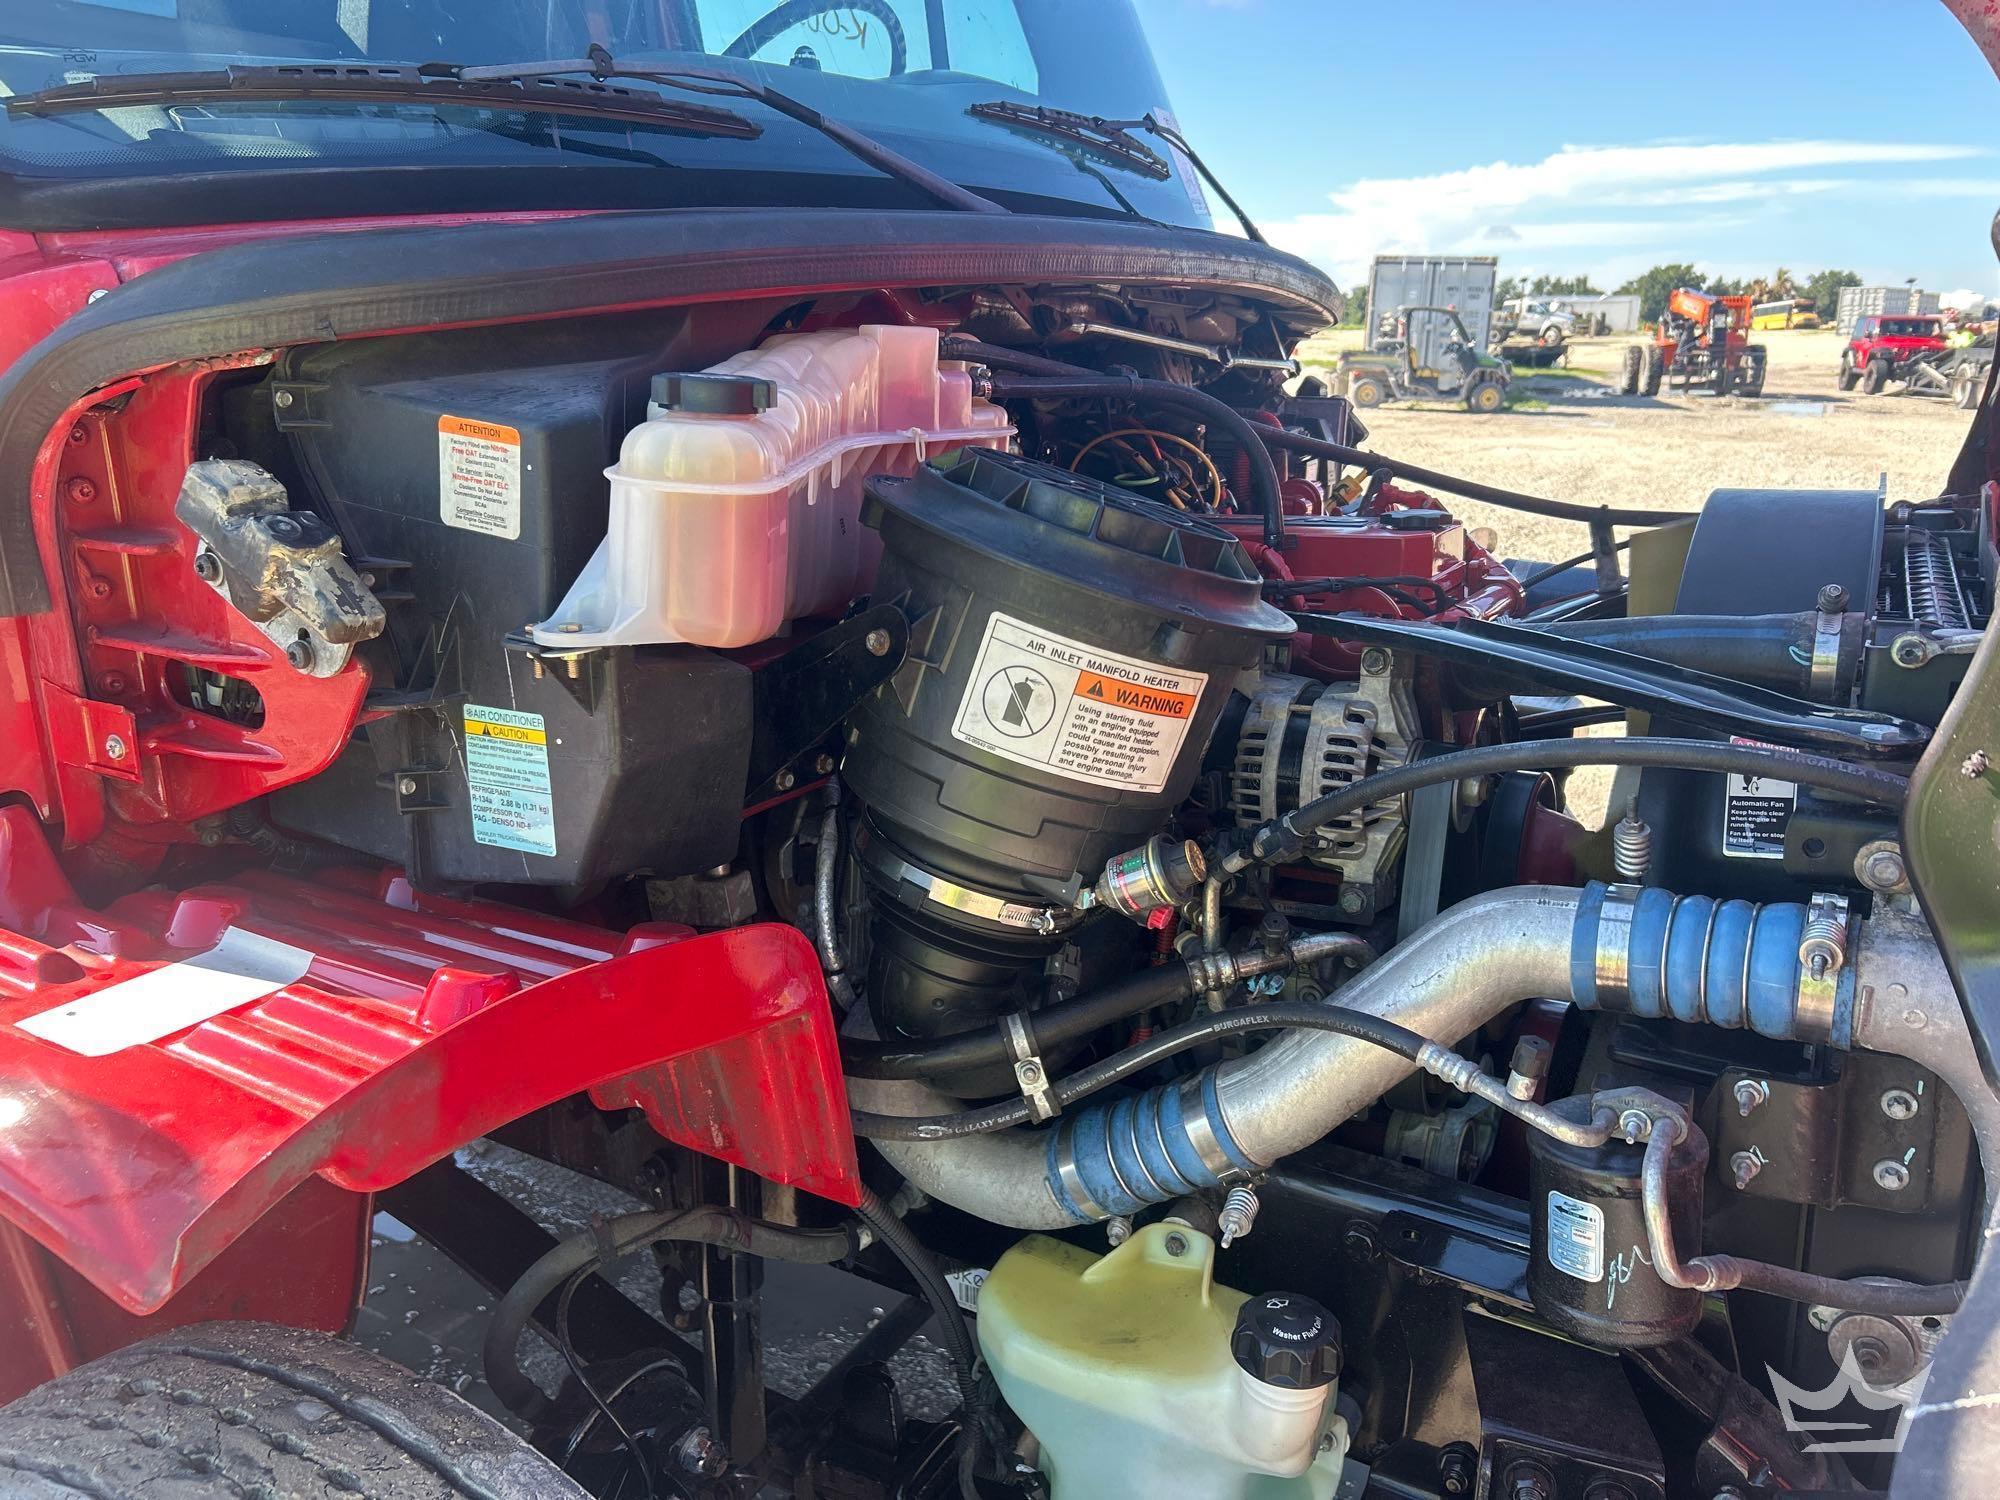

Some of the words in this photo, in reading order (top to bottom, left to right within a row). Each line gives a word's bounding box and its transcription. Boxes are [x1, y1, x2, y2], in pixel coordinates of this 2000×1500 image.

[63, 53, 97, 63] PGW
[458, 423, 500, 438] ATTENTION
[450, 438, 468, 448] Factory
[452, 446, 464, 455] Free
[465, 448, 478, 456] OAT
[479, 452, 499, 461] Extended
[465, 458, 482, 466] Coolant
[452, 473, 482, 484] Nitrite-Free
[497, 482, 508, 490] ELC
[494, 473, 504, 481] Only
[454, 490, 482, 500] Conventional
[456, 506, 482, 517] Compatible
[463, 515, 476, 523] Engine
[1026, 640, 1046, 653] AIR
[1050, 647, 1084, 666] INLET
[1086, 659, 1140, 681] MANIFOLD
[1144, 675, 1180, 690] HEATER
[1116, 688, 1184, 714] WARNING
[474, 709, 486, 719] AIR
[488, 711, 544, 728] CONDITIONER
[1078, 704, 1102, 717] Using
[1106, 712, 1135, 726] starting
[1138, 719, 1154, 728] fluid
[493, 726, 528, 740] CAUTION
[1075, 714, 1085, 722] on
[1101, 721, 1126, 732] engine
[1129, 727, 1160, 738] equipped
[1068, 730, 1090, 742] could
[1093, 738, 1115, 748] cause
[1072, 722, 1088, 732] with
[1099, 730, 1131, 742] manifold
[1134, 736, 1153, 746] heater
[468, 742, 489, 750] CONTAINS
[490, 746, 522, 756] REFRIGERANT
[499, 740, 524, 748] PRESSURE
[1064, 740, 1100, 755] possibly
[1102, 749, 1135, 763] resulting
[1058, 757, 1074, 766] and
[1076, 763, 1102, 773] engine
[1105, 768, 1133, 779] damage.
[1062, 749, 1088, 761] severe
[1092, 757, 1126, 769] personal
[1127, 763, 1147, 773] injury
[1774, 751, 1869, 777] BURGAFLEX
[471, 784, 512, 797] REFRIGERANT:
[472, 794, 492, 804] R-134a
[500, 799, 513, 807] 2.88
[515, 801, 521, 809] lb
[522, 802, 537, 811] (1.31
[539, 805, 549, 815] kg)
[473, 805, 512, 817] COMPRESSOR
[474, 814, 486, 822] PAG
[492, 817, 515, 827] DENSO
[1214, 1015, 1270, 1033] BURGAFLEX
[1328, 1020, 1369, 1036] GALAXY
[1370, 1032, 1382, 1041] SAE
[956, 1118, 995, 1134] GALAXY
[1272, 1326, 1300, 1340] Washer
[1302, 1327, 1318, 1340] Fluid
